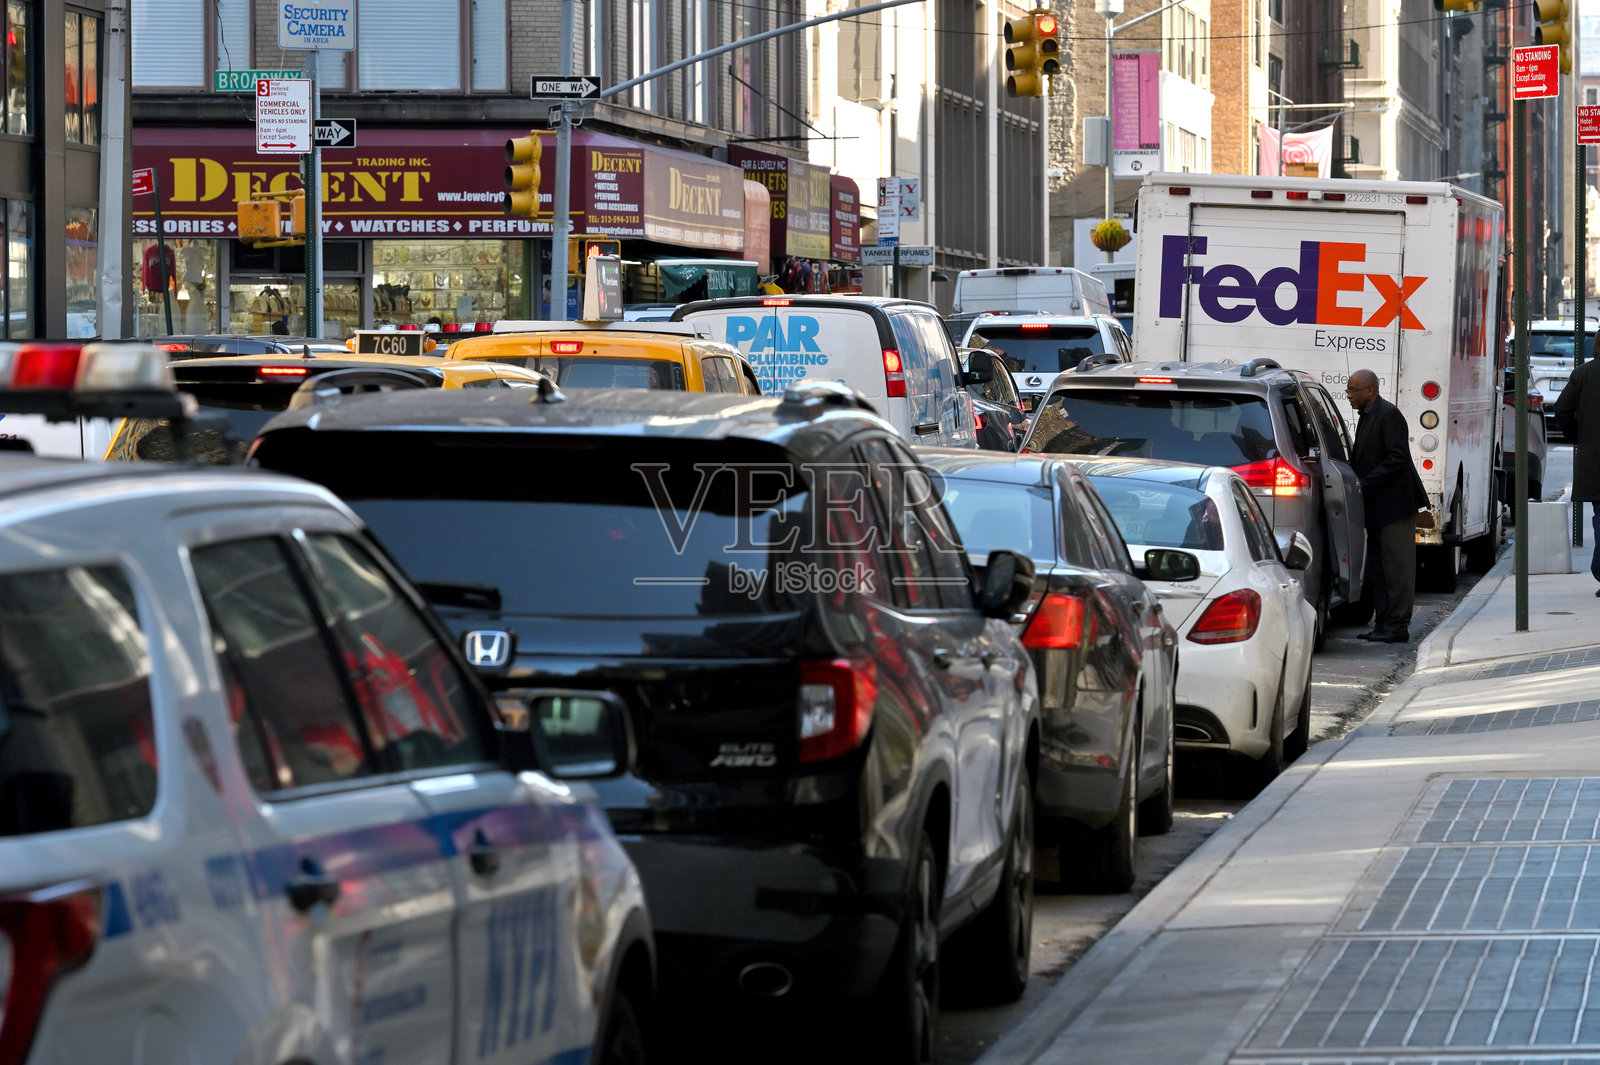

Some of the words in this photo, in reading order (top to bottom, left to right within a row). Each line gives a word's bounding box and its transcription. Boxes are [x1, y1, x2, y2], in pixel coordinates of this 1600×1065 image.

[284, 4, 349, 21] SECURITY
[287, 21, 346, 37] CAMERA
[1516, 52, 1523, 62] NO
[1524, 51, 1551, 61] STANDING
[1516, 74, 1530, 82] Except
[1531, 73, 1546, 82] Sunday
[259, 81, 268, 96] 3
[542, 82, 560, 92] ONE
[570, 83, 590, 92] WAY
[317, 128, 342, 138] WAY
[356, 158, 406, 166] TRADING
[408, 158, 431, 166] INC.
[592, 151, 642, 173] DECENT
[741, 160, 752, 169] FAIR
[758, 160, 776, 170] LOVELY
[777, 160, 786, 170] INC.
[597, 172, 616, 180] JEWELRY
[597, 182, 618, 191] WATCHES
[669, 167, 722, 216] DECENT
[597, 192, 620, 201] PERFUMES
[1347, 194, 1380, 202] 222831
[608, 203, 638, 212] ACCESSORIES
[351, 220, 450, 232] WATCHES
[468, 220, 574, 232] PERFUMS
[1160, 234, 1428, 330] FedEx
[726, 316, 822, 352] PAR
[373, 336, 406, 354] 7C60
[1315, 330, 1386, 352] Express
[748, 354, 828, 366] PLUMBING
[710, 754, 778, 767] AWD
